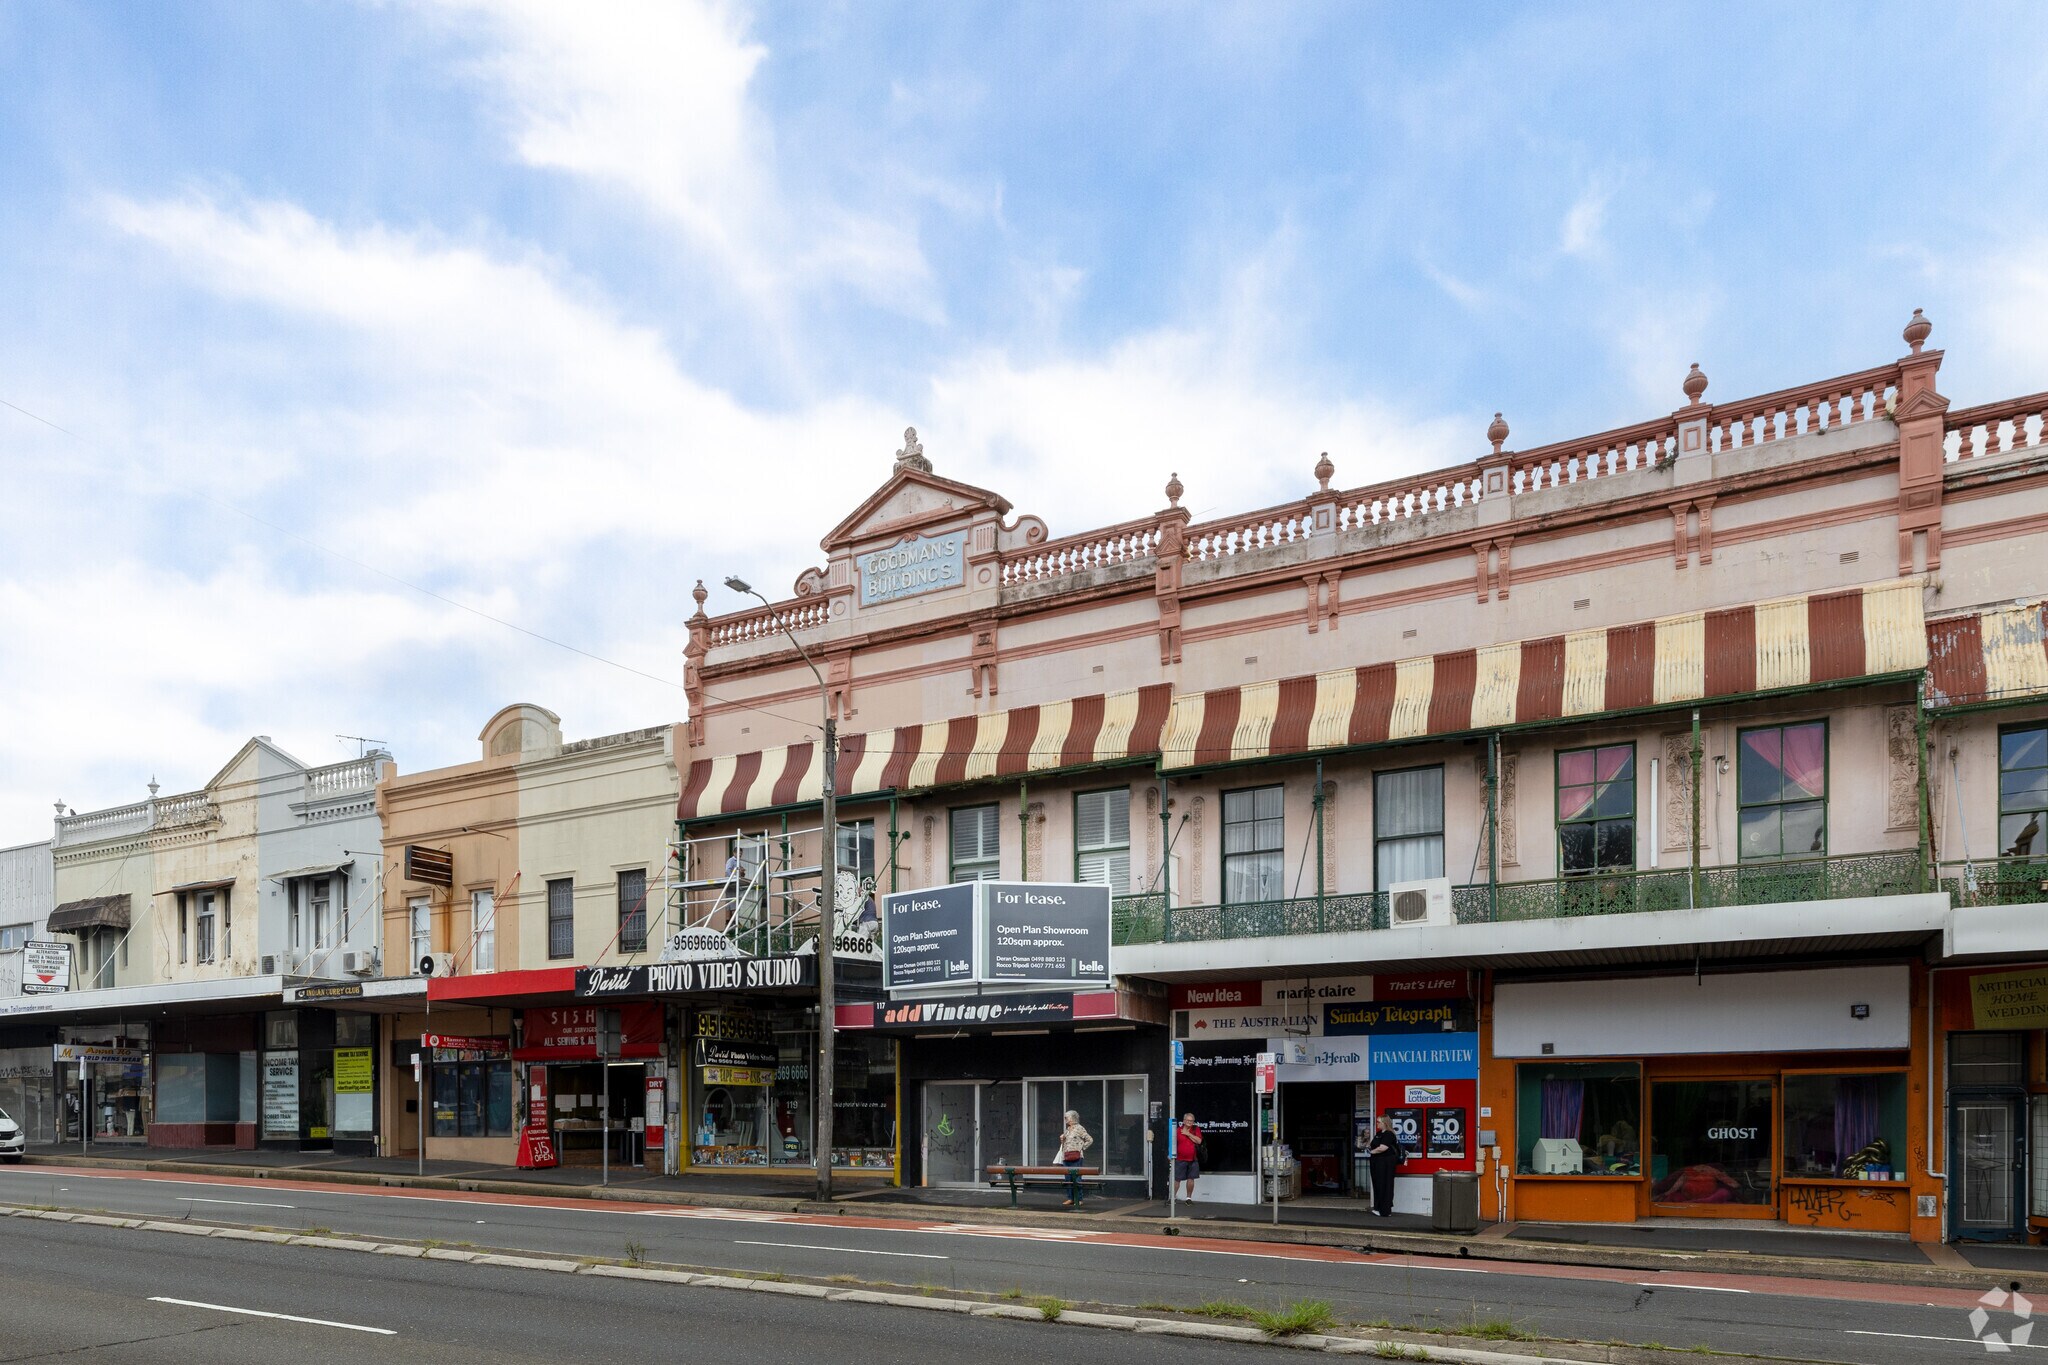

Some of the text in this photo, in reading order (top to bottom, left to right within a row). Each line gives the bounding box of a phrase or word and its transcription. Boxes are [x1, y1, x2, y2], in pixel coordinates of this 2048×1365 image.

[866, 540, 956, 576] GOODMAN'S
[997, 892, 1066, 905] For lease.
[893, 900, 941, 914] For lease.
[893, 928, 958, 944] Open Plan Showroom
[996, 925, 1088, 935] Open Plan Showroom
[674, 935, 726, 951] 95696666
[893, 943, 940, 955] 120sqm approx.
[996, 937, 1065, 948] 120sqm approx.
[950, 960, 970, 972] belle
[1079, 960, 1104, 972] belle
[584, 957, 800, 997] David PHOTO VIDEO STUDIO
[345, 986, 360, 994] CLUB
[1389, 979, 1456, 991] That's Life!
[1976, 977, 2048, 993] ARTIFICIAL
[1188, 988, 1242, 1004] New Idea
[1277, 985, 1356, 999] marie claire
[1992, 992, 2038, 1005] HOME
[876, 1002, 886, 1010] 117
[884, 1003, 1002, 1022] addVintage
[1987, 1004, 2048, 1018] WEDDIN
[1212, 1015, 1318, 1028] THE AUSTRALIAN
[1330, 1004, 1452, 1026] Sunday Telegraph
[544, 1038, 555, 1047] ALL
[709, 1045, 729, 1059] David
[1373, 1049, 1473, 1063] FINANCIAL REVIEW
[264, 1057, 299, 1067] INCOME TAX
[1189, 1056, 1213, 1066] Sydney
[1214, 1055, 1242, 1066] Morning
[269, 1067, 293, 1076] SERVICE
[791, 1065, 808, 1080] 6666
[786, 1100, 798, 1109] 119
[1209, 1121, 1230, 1129] Morning
[1231, 1120, 1248, 1128] Herald
[1431, 1118, 1460, 1135] $50
[1707, 1127, 1758, 1140] GHOST
[534, 1141, 550, 1155] $15
[534, 1153, 554, 1162] OPEN
